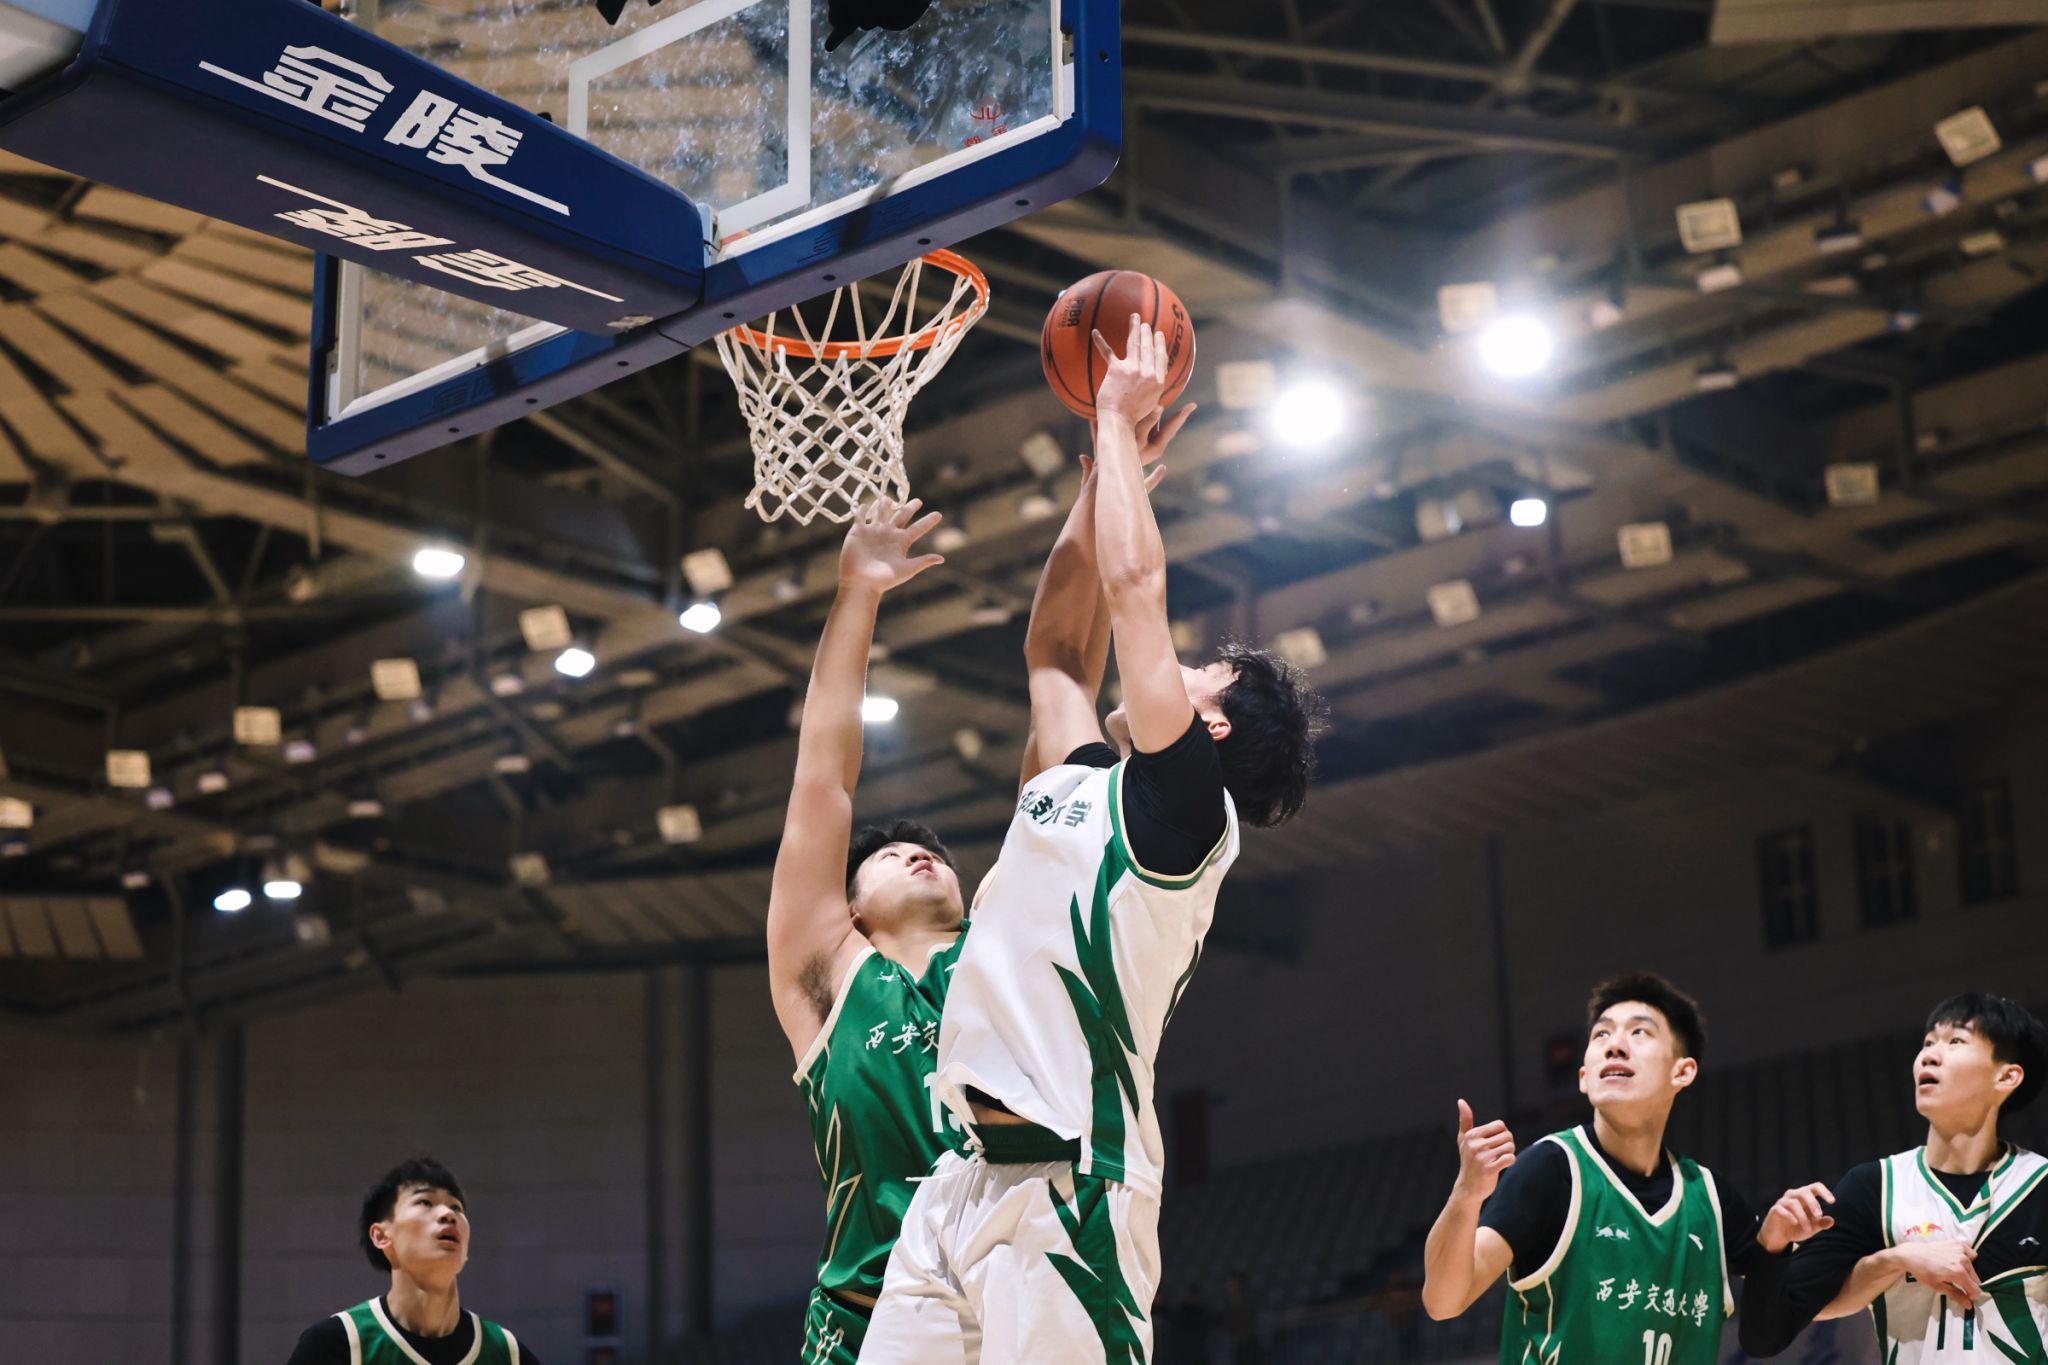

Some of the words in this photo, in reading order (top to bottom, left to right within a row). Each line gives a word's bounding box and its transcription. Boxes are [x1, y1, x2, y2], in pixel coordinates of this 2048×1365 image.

[199, 45, 570, 216] 金陵
[256, 174, 624, 302] 金陵
[923, 1071, 961, 1133] 1
